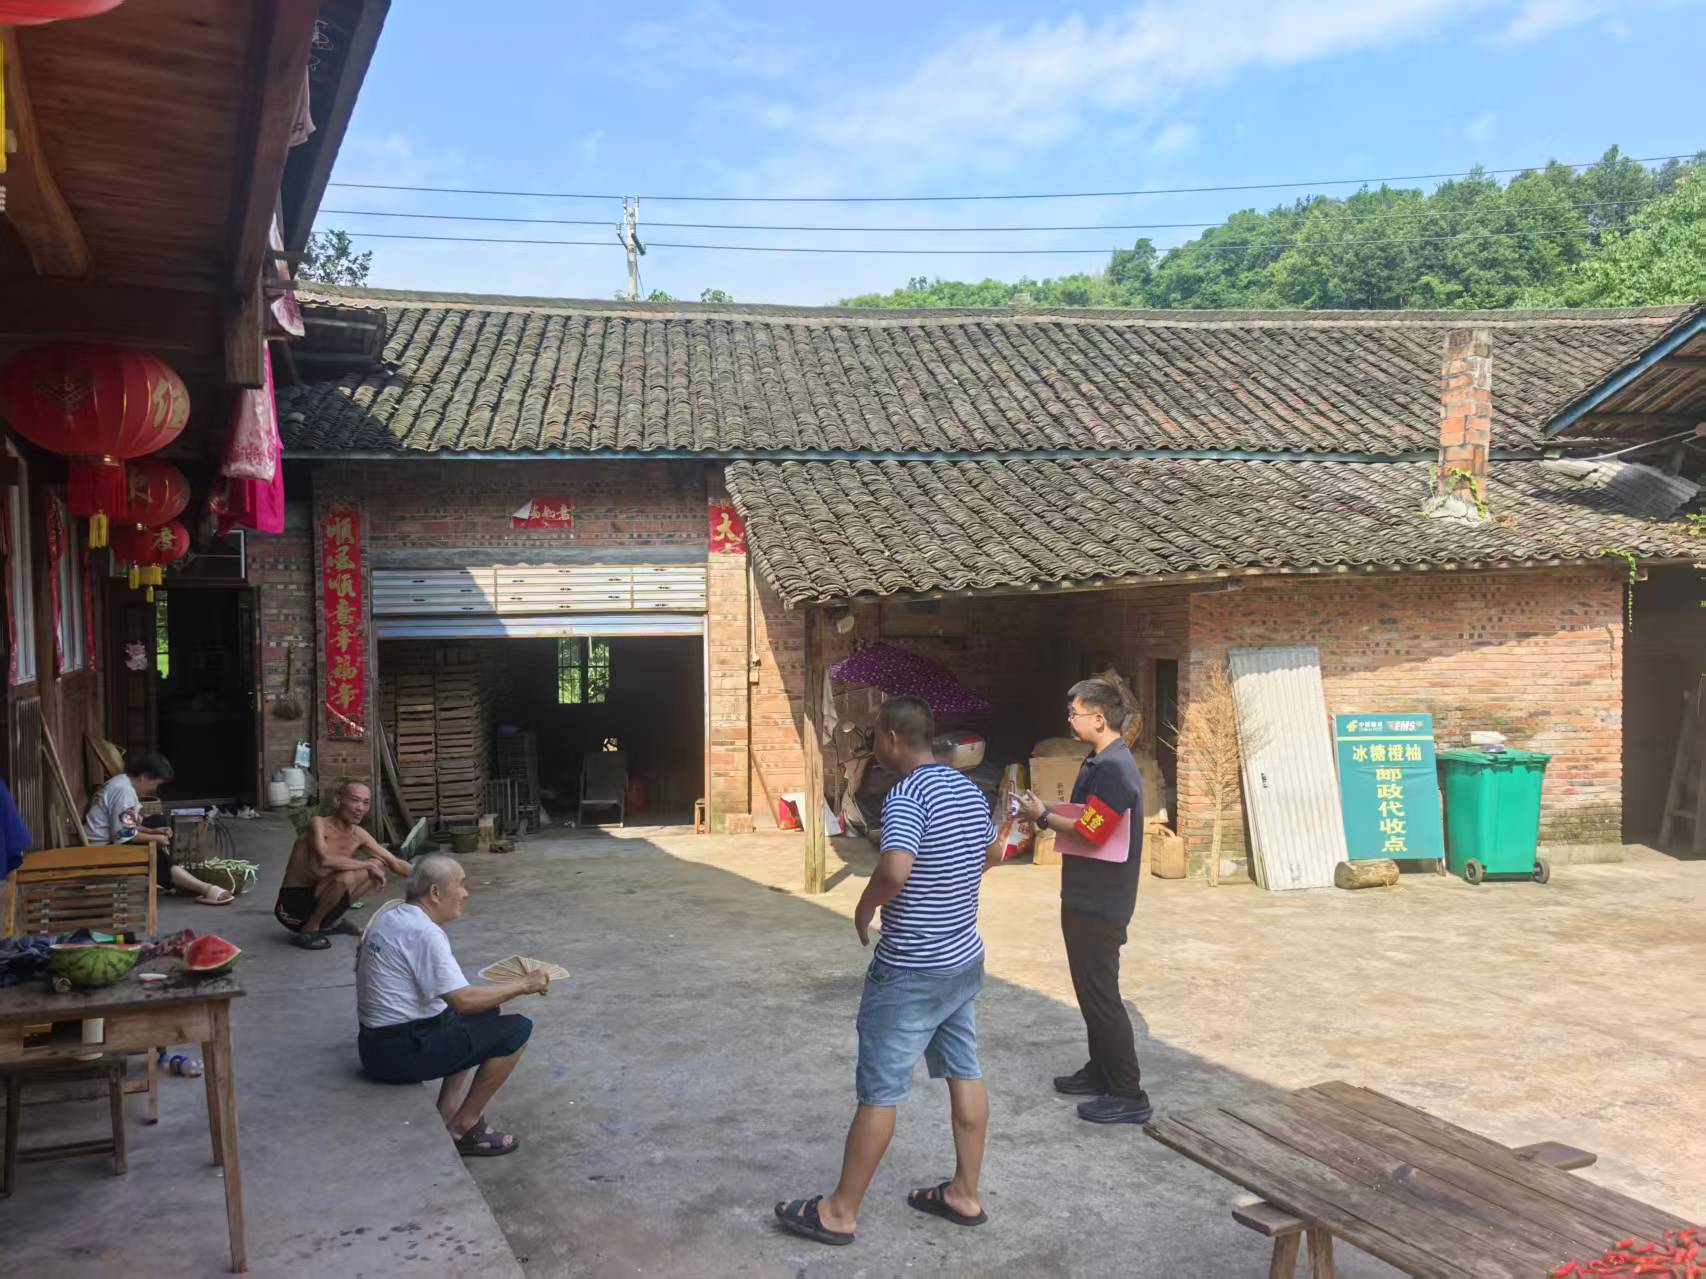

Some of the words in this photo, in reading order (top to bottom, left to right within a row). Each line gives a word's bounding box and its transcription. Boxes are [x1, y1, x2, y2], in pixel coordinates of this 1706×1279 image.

[1393, 720, 1416, 732] EMS
[1352, 744, 1422, 762] 冰糖橙柚
[1376, 767, 1408, 852] 邮政代收点
